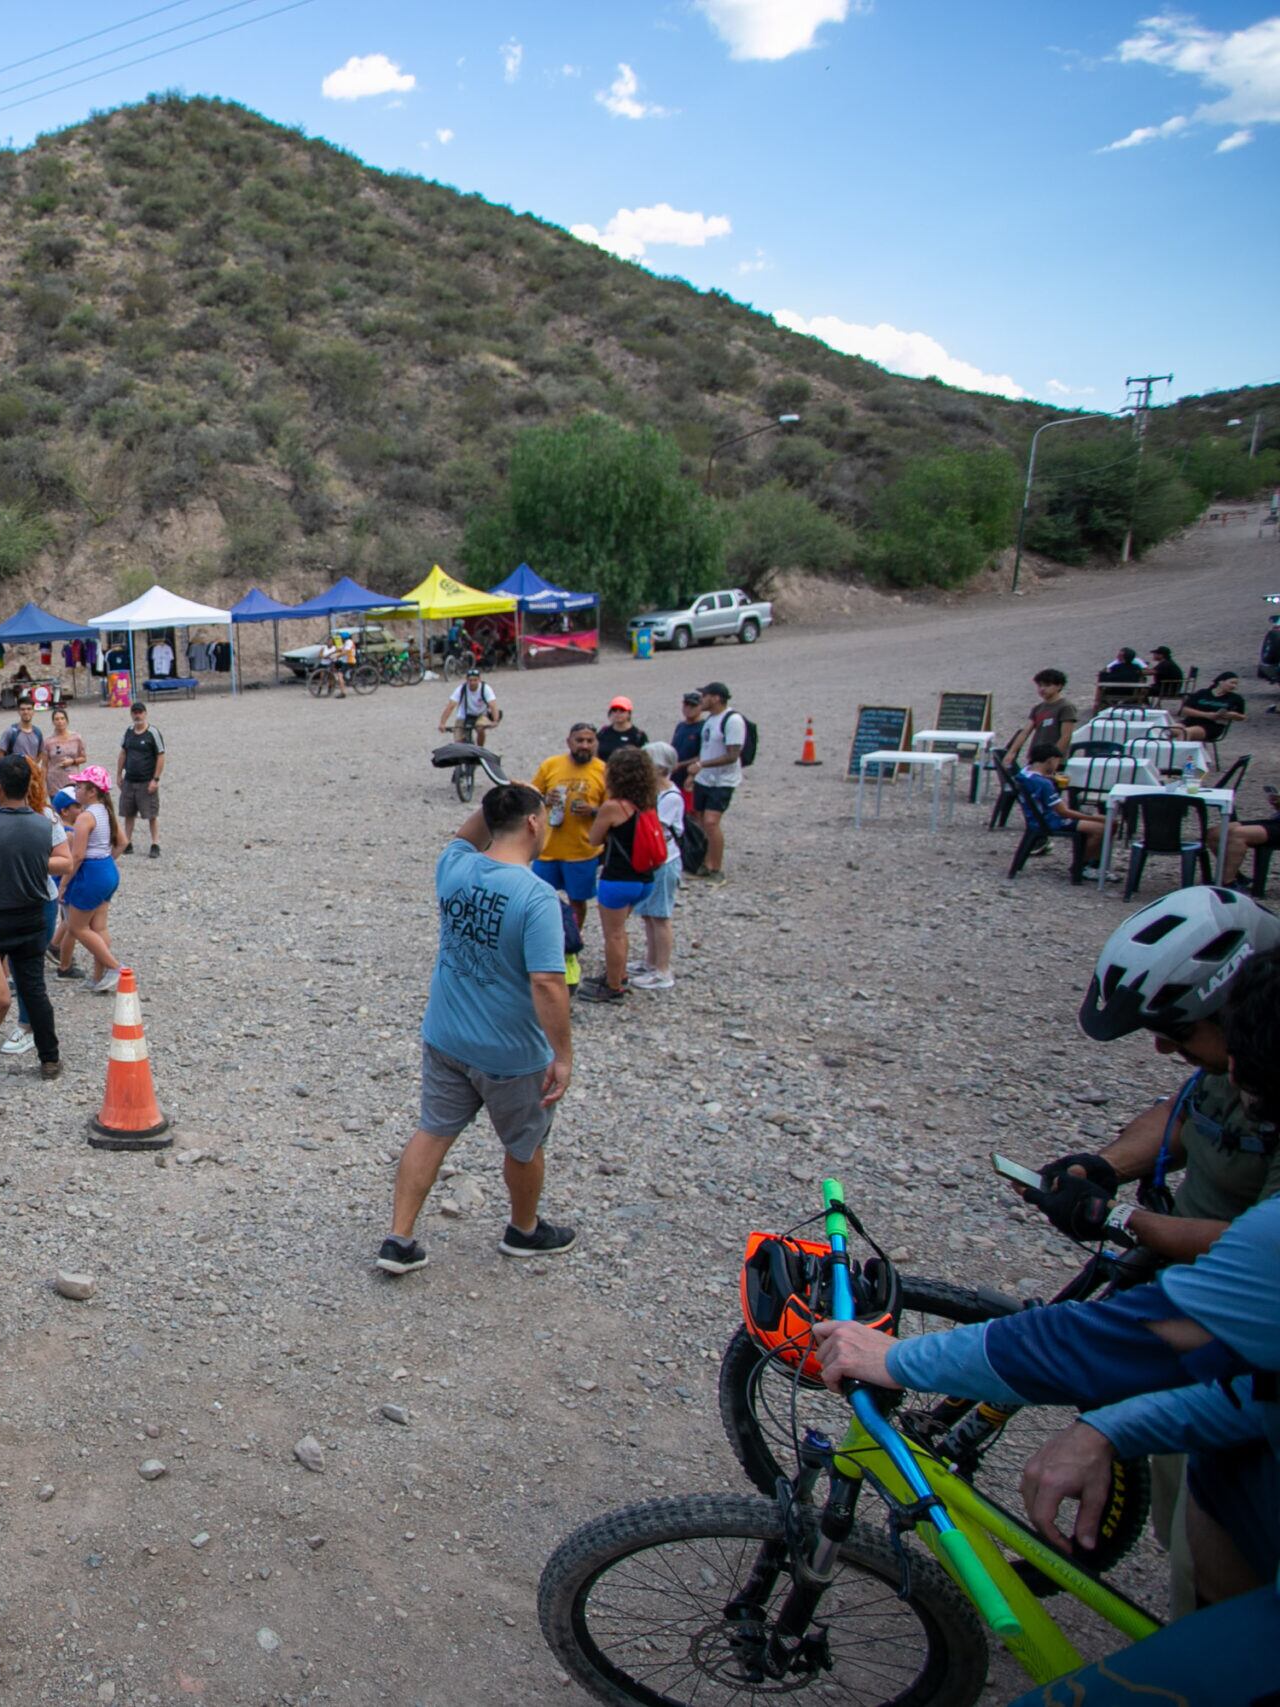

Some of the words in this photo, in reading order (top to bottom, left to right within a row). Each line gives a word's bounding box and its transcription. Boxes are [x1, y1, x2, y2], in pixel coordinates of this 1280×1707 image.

[440, 897, 502, 938] NORTH
[471, 885, 510, 915] THE
[451, 919, 499, 950] FACE
[943, 1408, 991, 1456] FOX
[1101, 1460, 1126, 1539] MAXXIS
